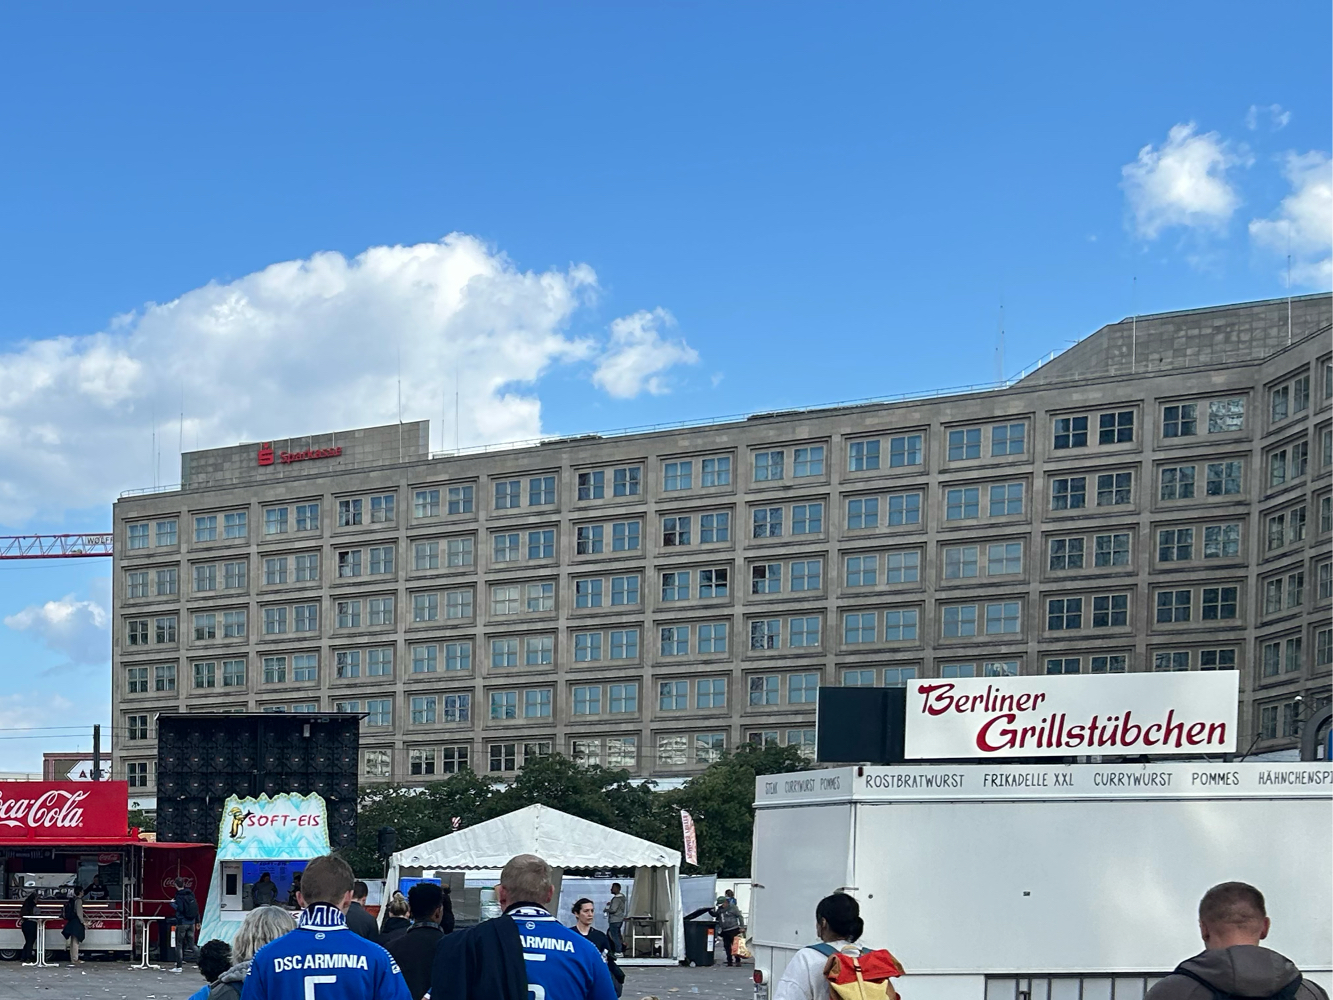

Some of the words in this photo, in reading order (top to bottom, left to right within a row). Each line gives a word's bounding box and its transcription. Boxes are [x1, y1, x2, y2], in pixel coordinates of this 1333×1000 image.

[279, 446, 343, 465] Sparkasse
[917, 682, 1046, 716] Berliner
[975, 709, 1227, 752] Grillstübchen
[784, 778, 816, 793] CURRYWURST
[820, 776, 841, 791] POMMES
[865, 773, 965, 789] ROSTBRATWURST
[983, 772, 1049, 787] FRIKADELLE
[1053, 772, 1075, 787] XXL
[1094, 772, 1173, 787] CURRYWURST
[1191, 771, 1240, 786] POMMES
[247, 814, 321, 827] SOFT-EIS
[273, 955, 303, 973] DSC
[303, 953, 369, 971] ARMINIA
